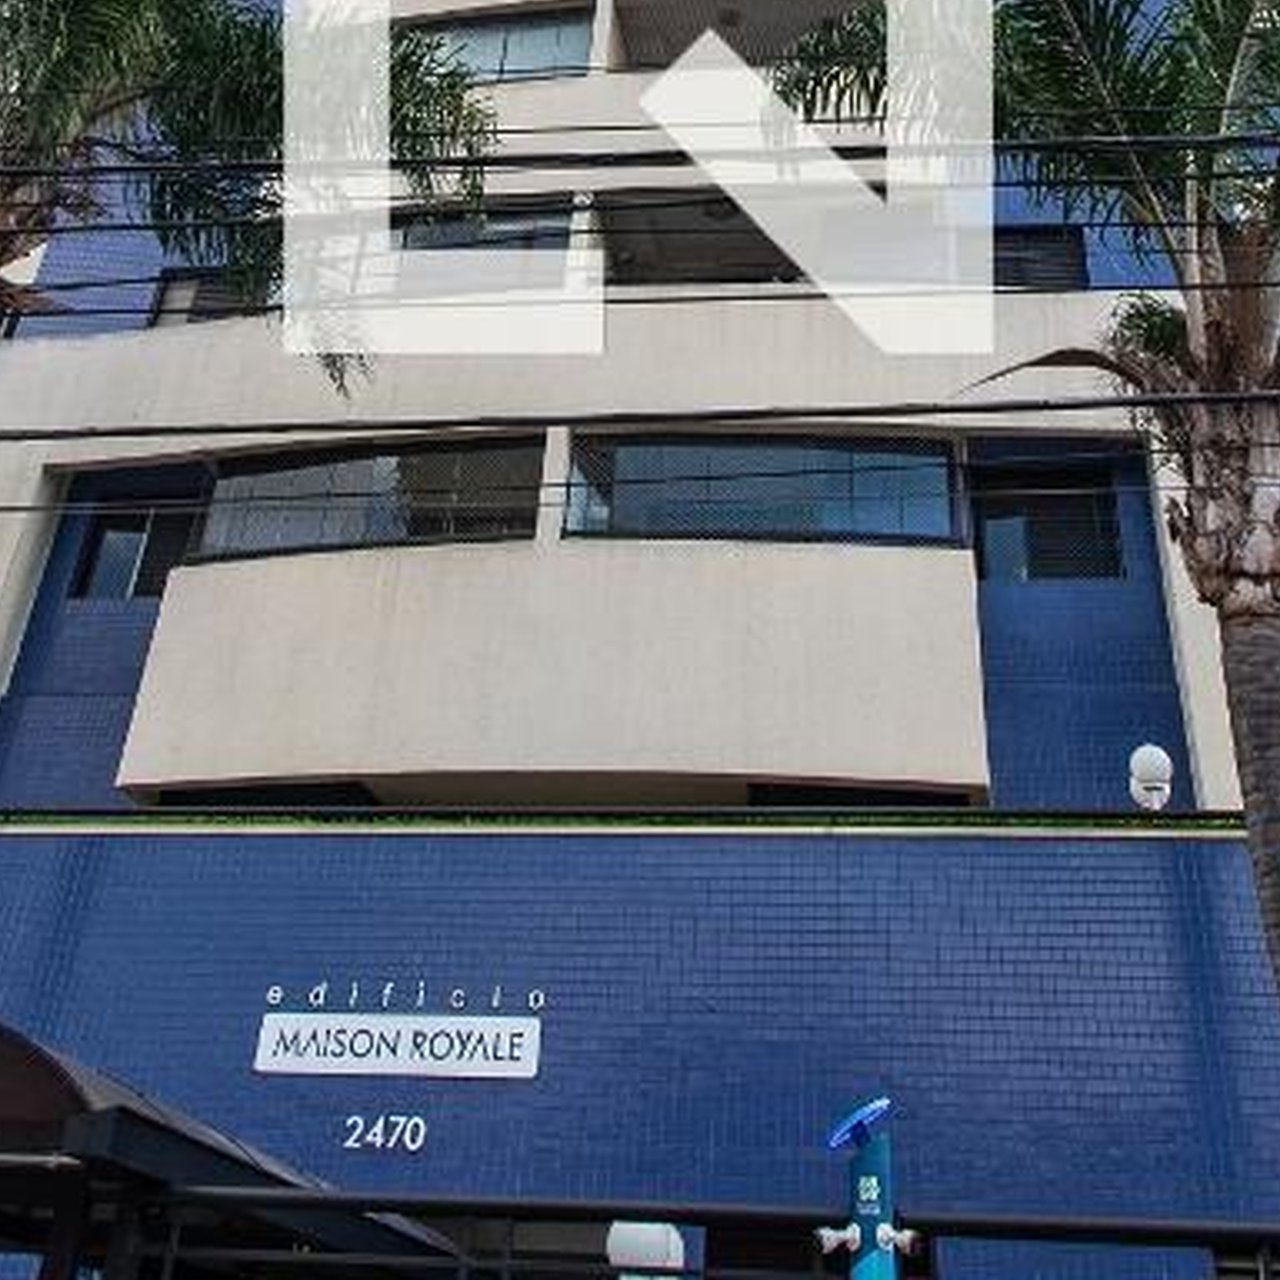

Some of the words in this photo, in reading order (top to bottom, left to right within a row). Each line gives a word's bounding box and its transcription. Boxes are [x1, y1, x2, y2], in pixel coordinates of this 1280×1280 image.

[272, 1028, 400, 1058] MAISON
[410, 1029, 524, 1061] ROYALE
[343, 1115, 426, 1151] 2470
